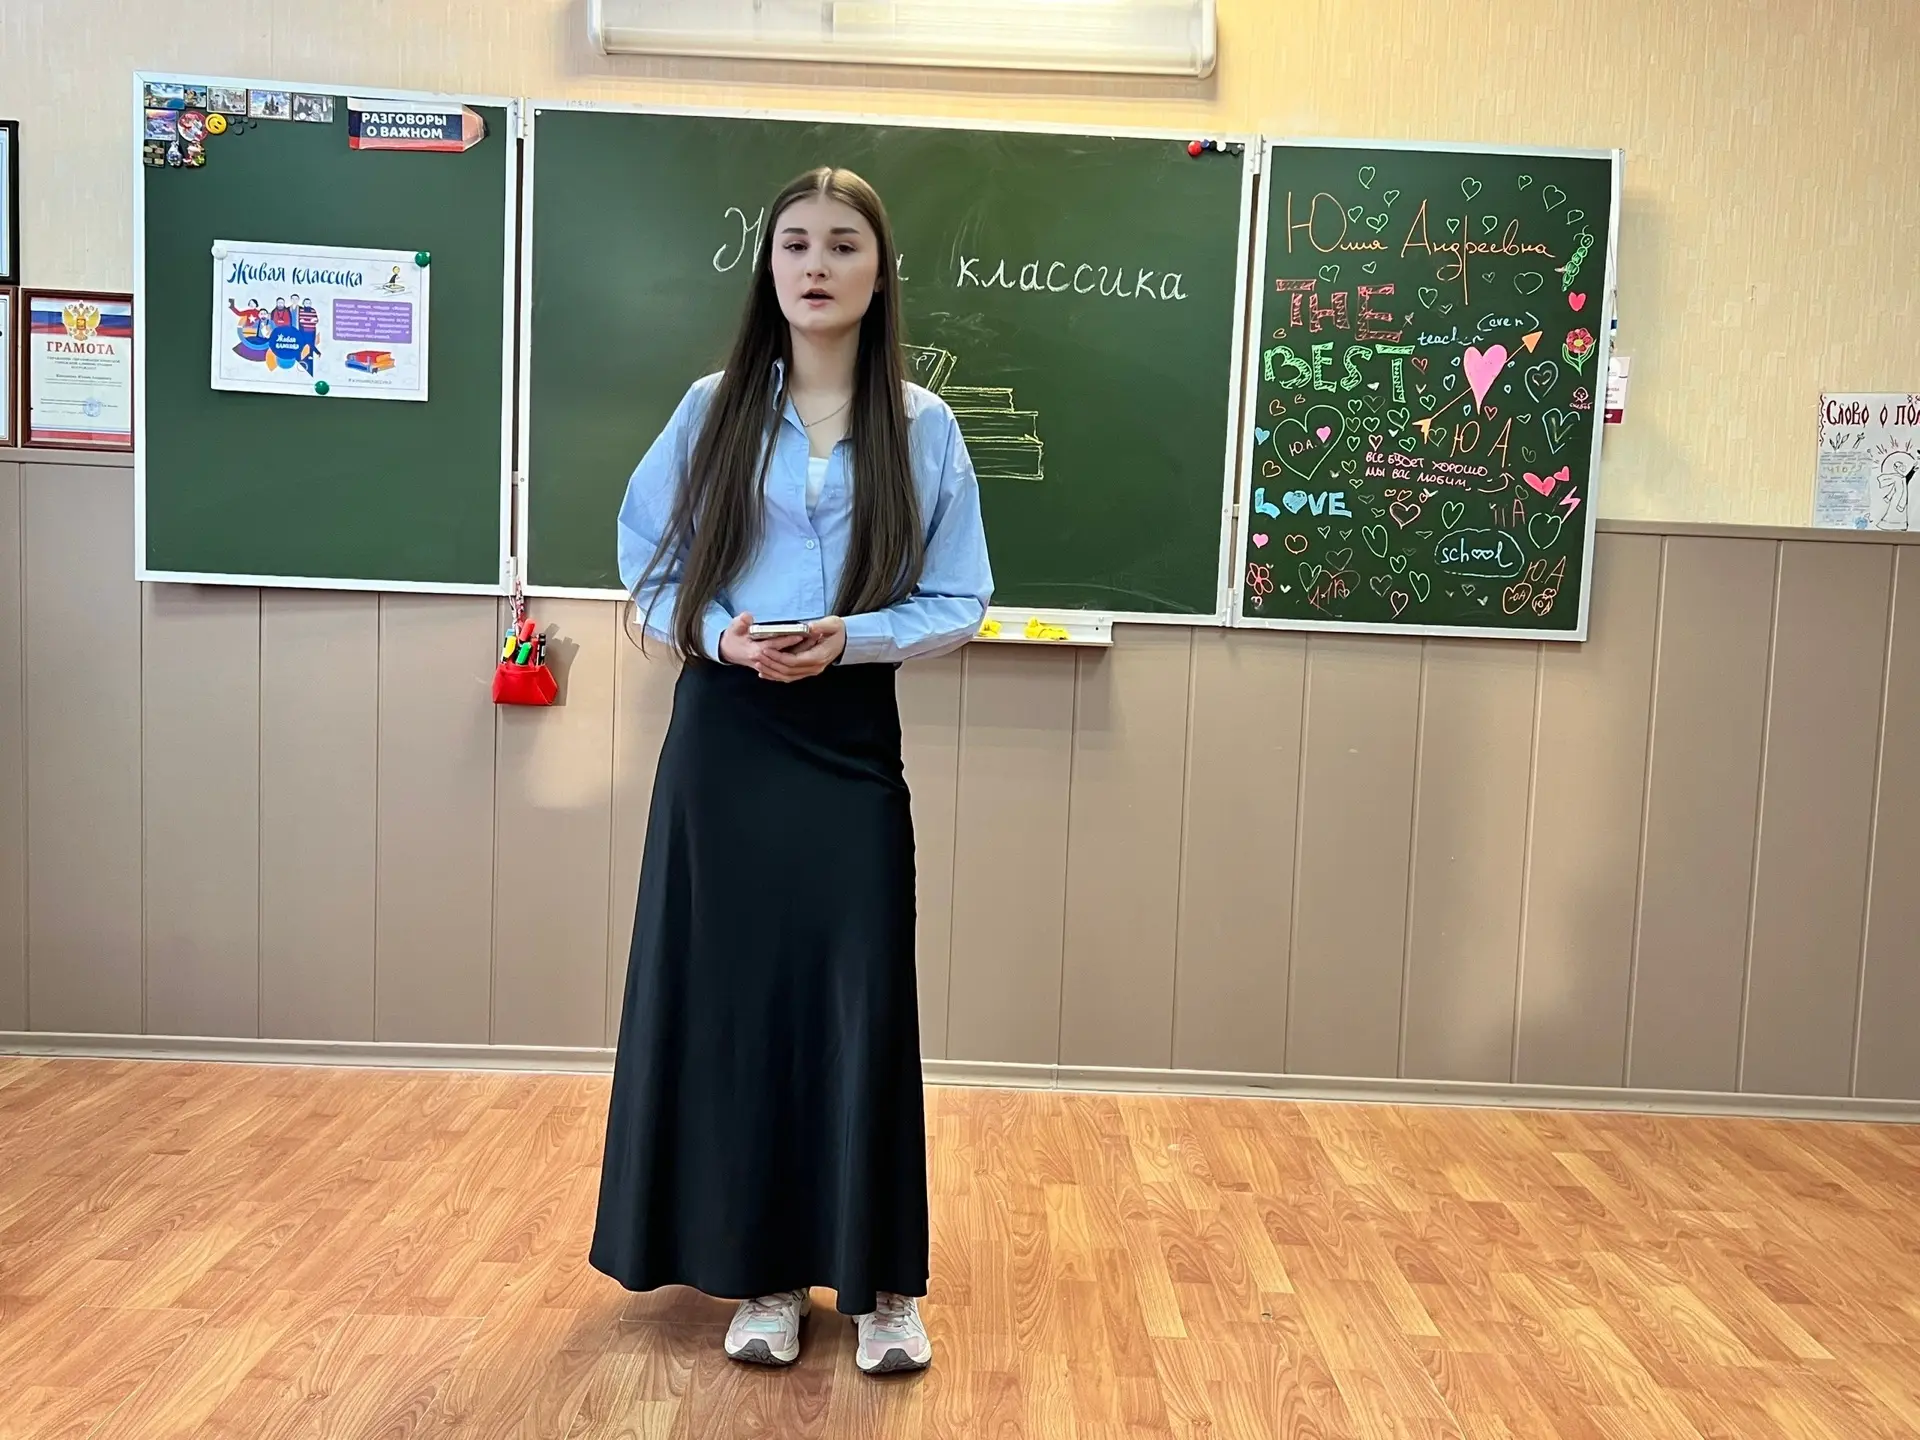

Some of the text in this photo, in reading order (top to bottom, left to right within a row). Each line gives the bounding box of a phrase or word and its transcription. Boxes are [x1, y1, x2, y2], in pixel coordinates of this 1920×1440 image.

[361, 112, 447, 126] РАЗГОВОРЫ
[366, 126, 443, 139] О ВАЖНОМ
[1287, 191, 1556, 306] Юлия Андреевна
[227, 258, 363, 288] Живая классика
[955, 254, 1189, 301] классика
[1275, 279, 1403, 343] THE
[46, 341, 115, 355] ГРАМОТА
[1263, 341, 1416, 403] BEST
[1441, 540, 1514, 568] school
